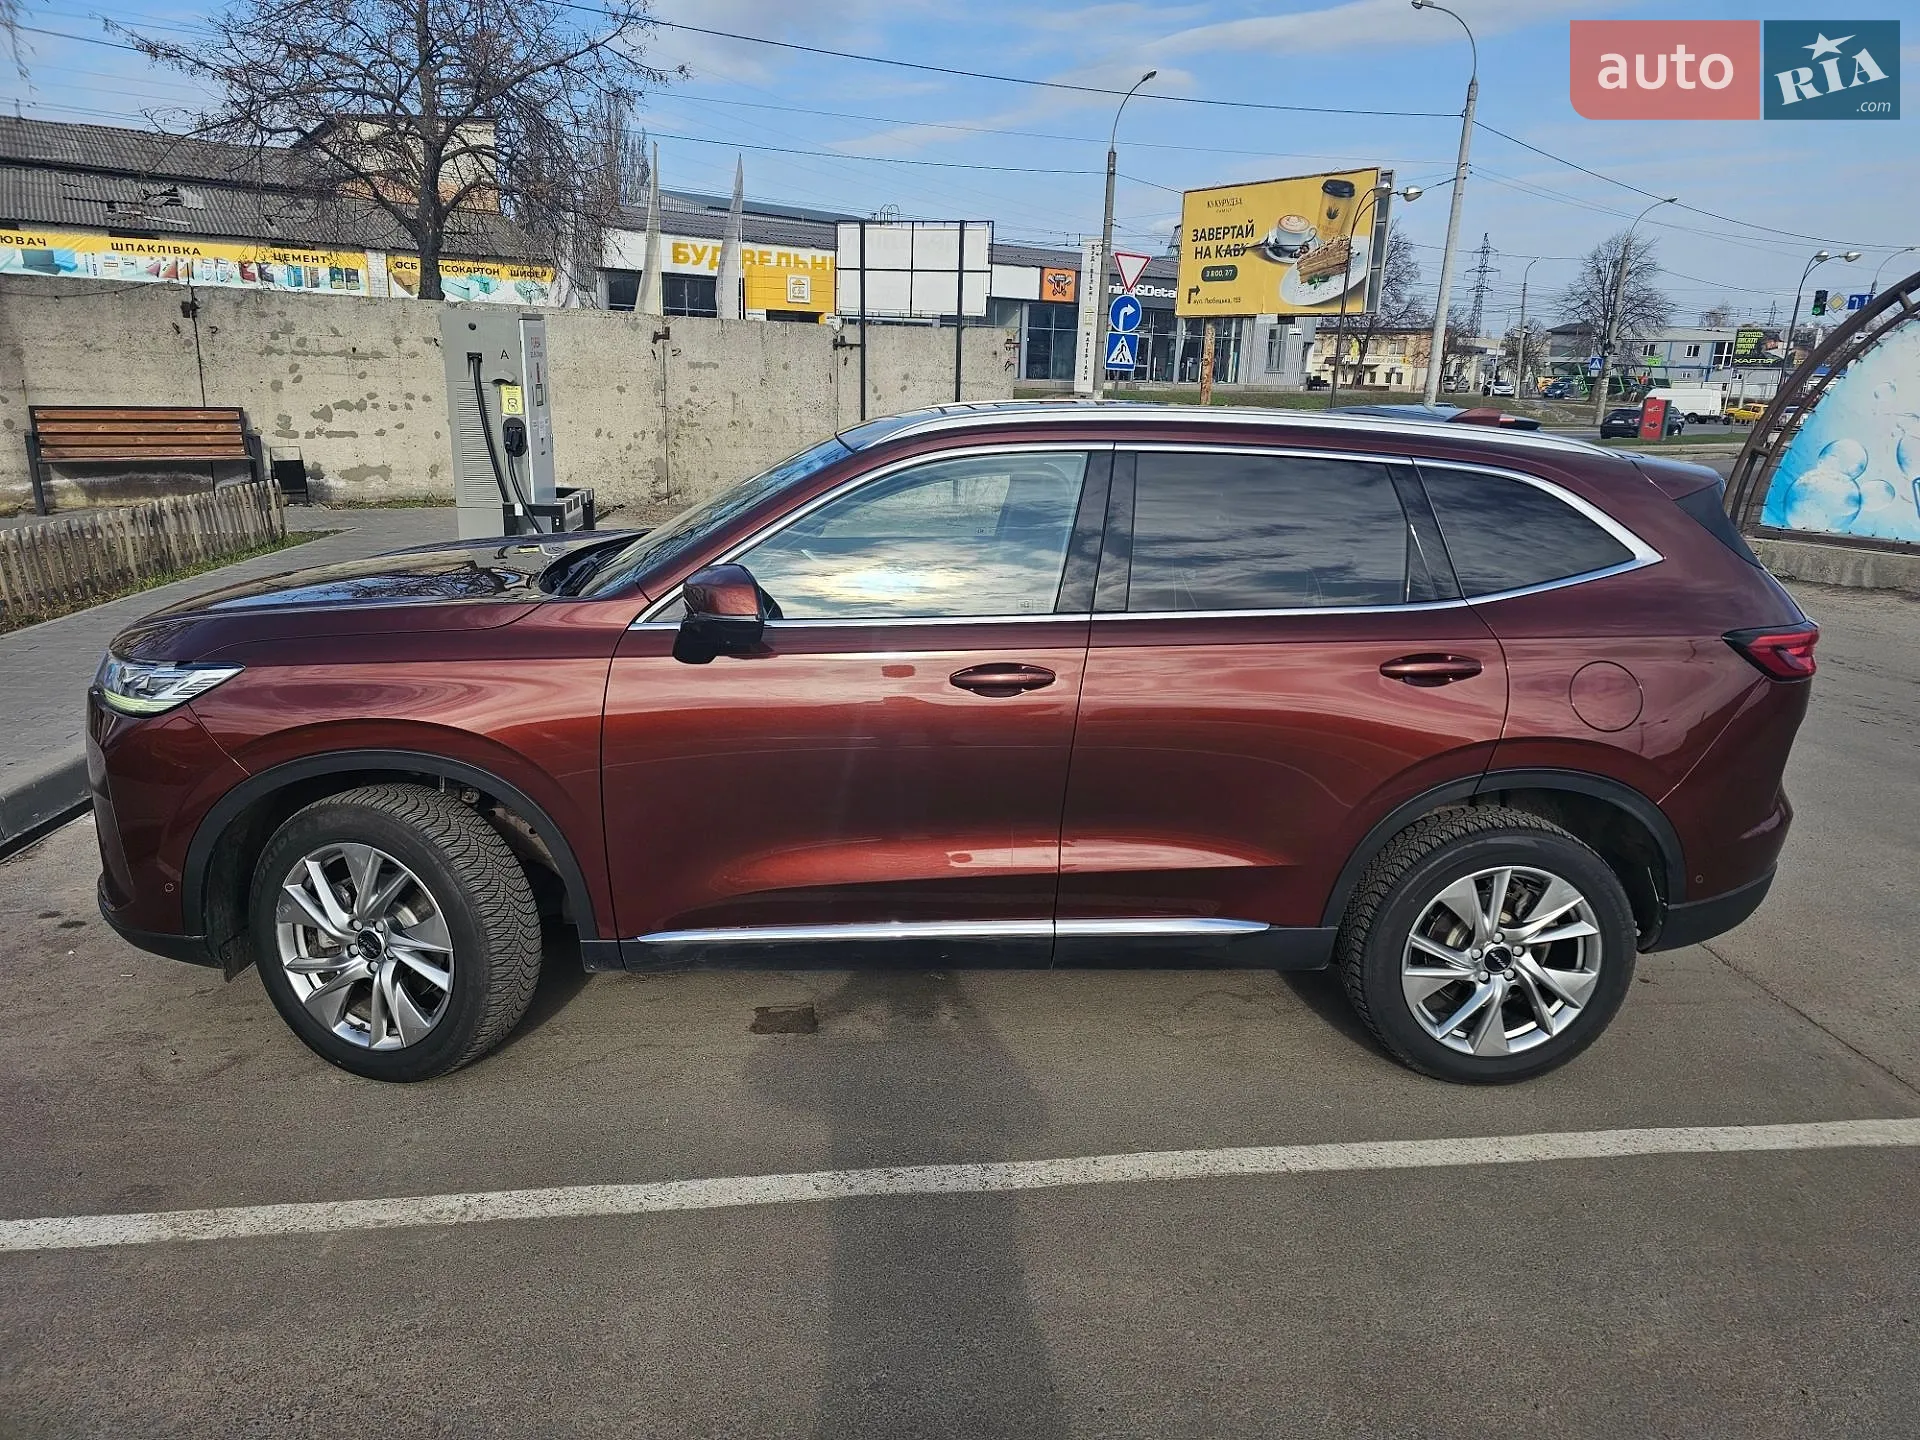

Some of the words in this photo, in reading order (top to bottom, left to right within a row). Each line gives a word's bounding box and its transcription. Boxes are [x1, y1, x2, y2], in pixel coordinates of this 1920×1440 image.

[1191, 219, 1255, 242] ЗАВЕРТАЙ
[0, 234, 47, 247] ЮВАЧ
[111, 242, 201, 256] ШПАКЛІВКА
[1195, 245, 1212, 260] НА
[1215, 243, 1249, 259] КАВУ
[273, 253, 328, 264] ЦЕМЕНТ
[395, 261, 418, 270] ОСБ
[500, 349, 510, 359] A
